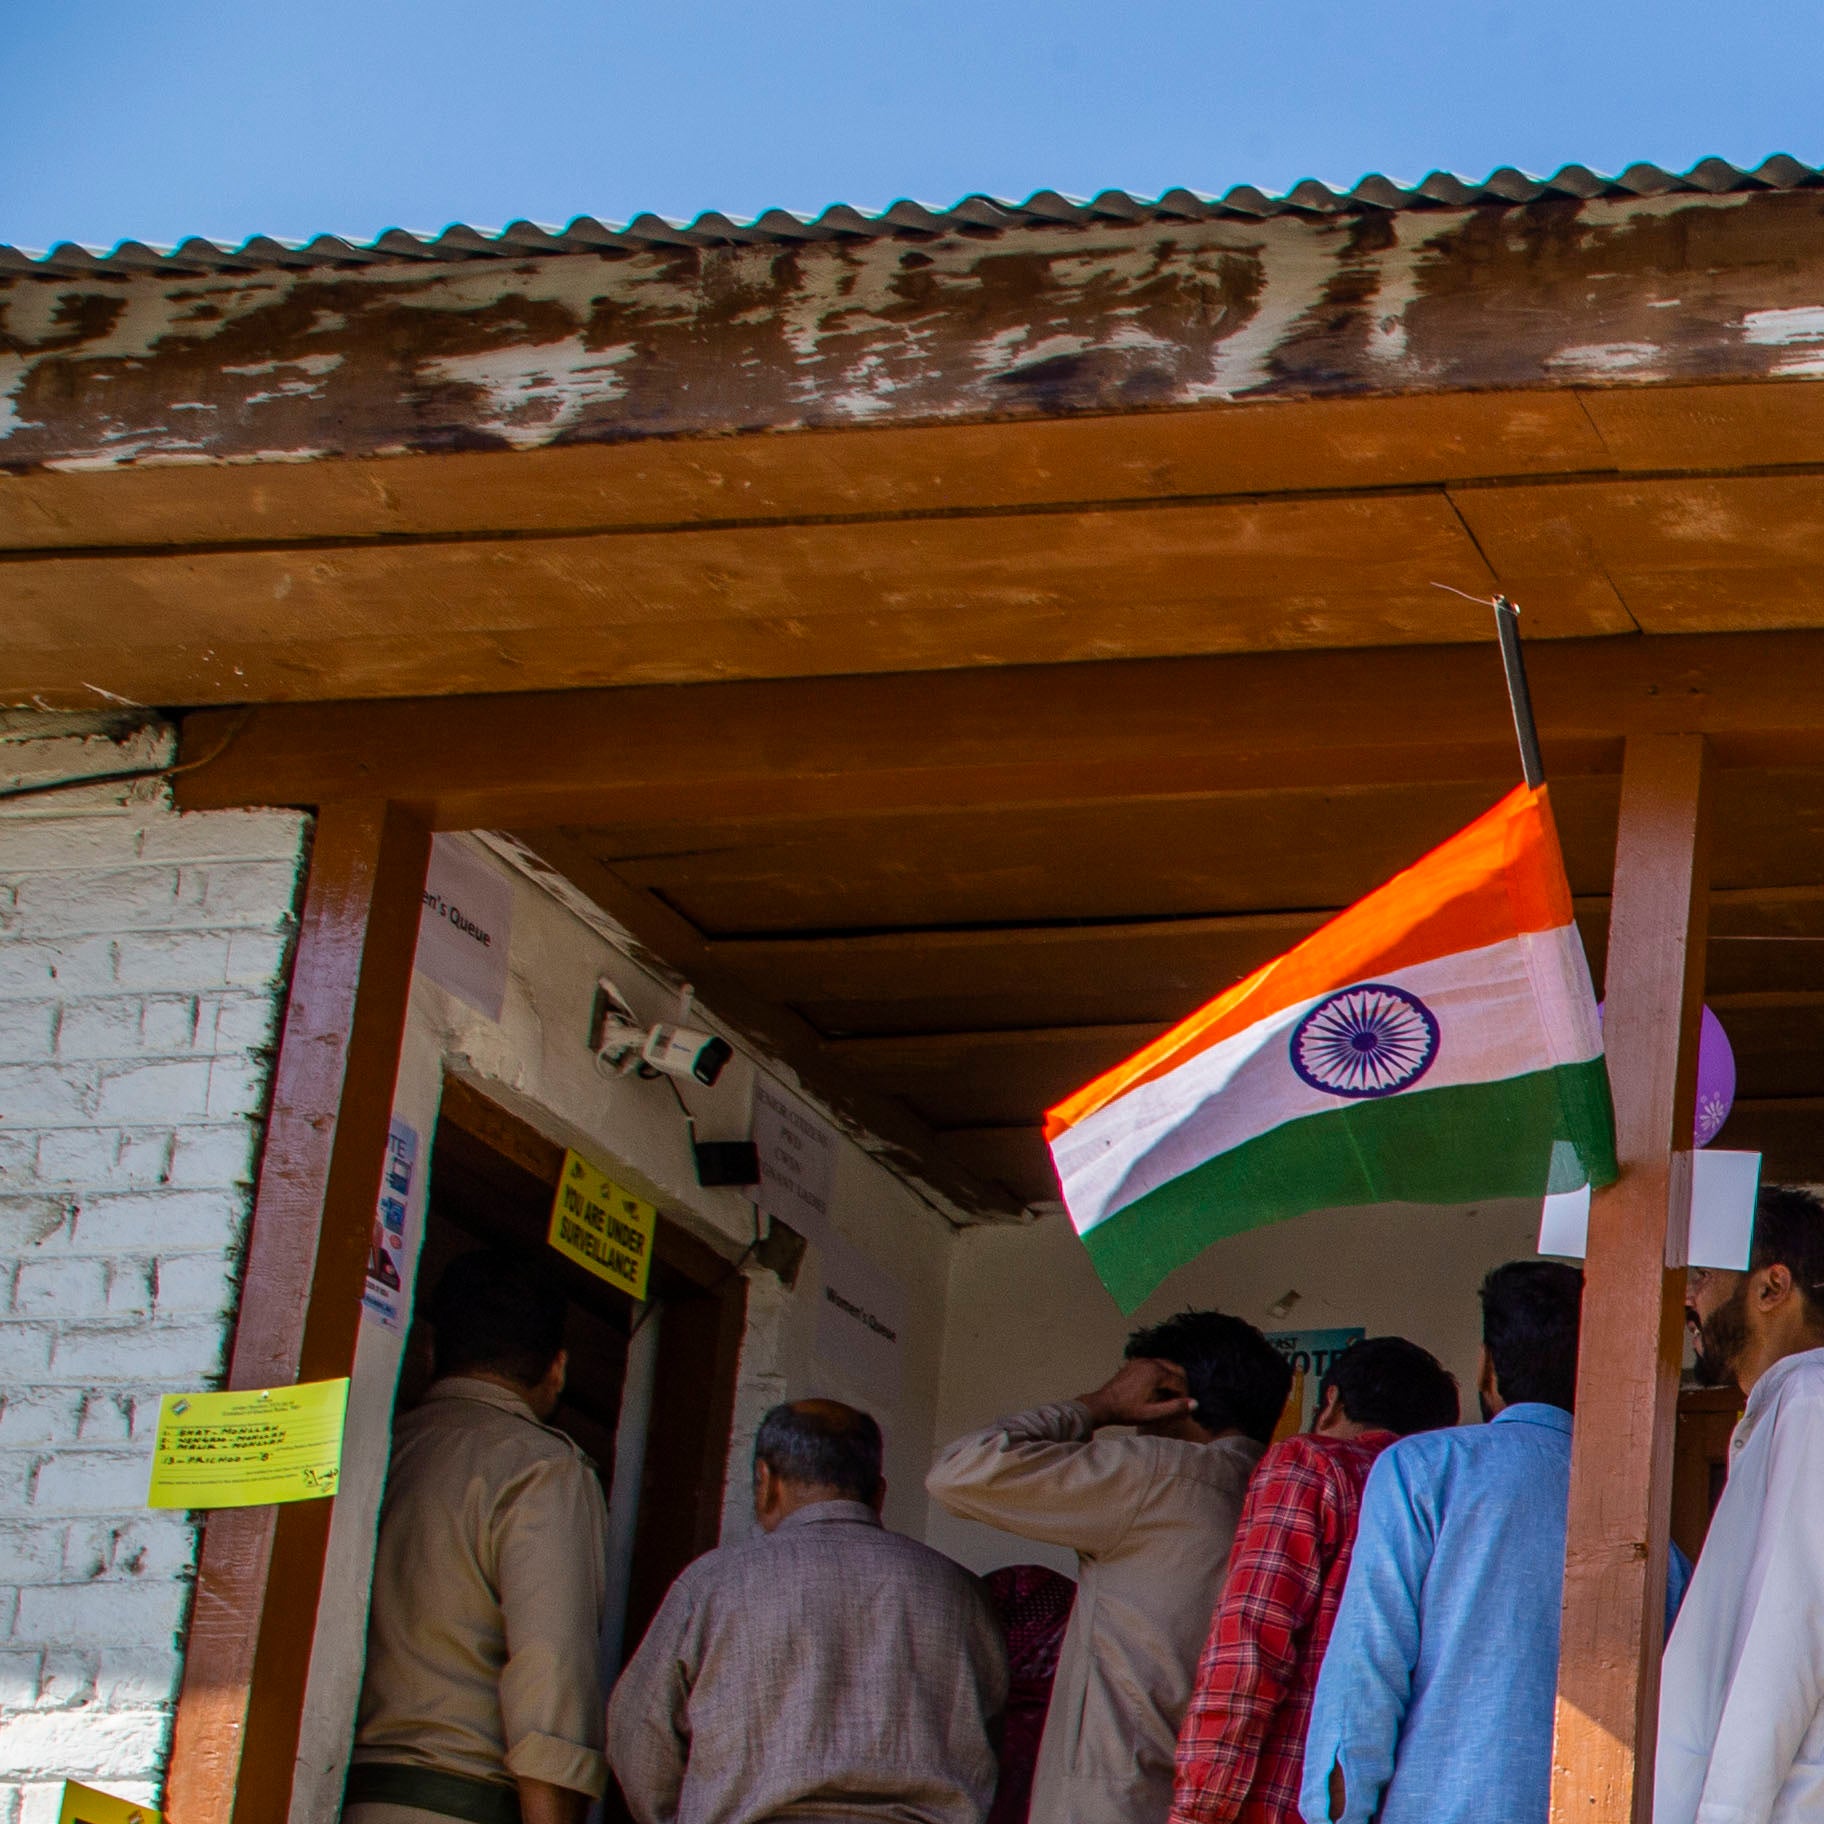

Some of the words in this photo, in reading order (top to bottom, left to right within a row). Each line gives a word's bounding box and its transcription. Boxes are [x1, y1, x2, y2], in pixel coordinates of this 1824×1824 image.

[420, 890, 447, 916] en's
[449, 907, 491, 947] Queue
[388, 1133, 408, 1158] TE
[559, 1215, 639, 1284] SURVEILLANCE
[563, 1183, 584, 1217] YOU
[584, 1201, 606, 1233] ARE
[606, 1215, 645, 1257] UNDER
[825, 1285, 868, 1325] Women's
[868, 1314, 897, 1344] Queue
